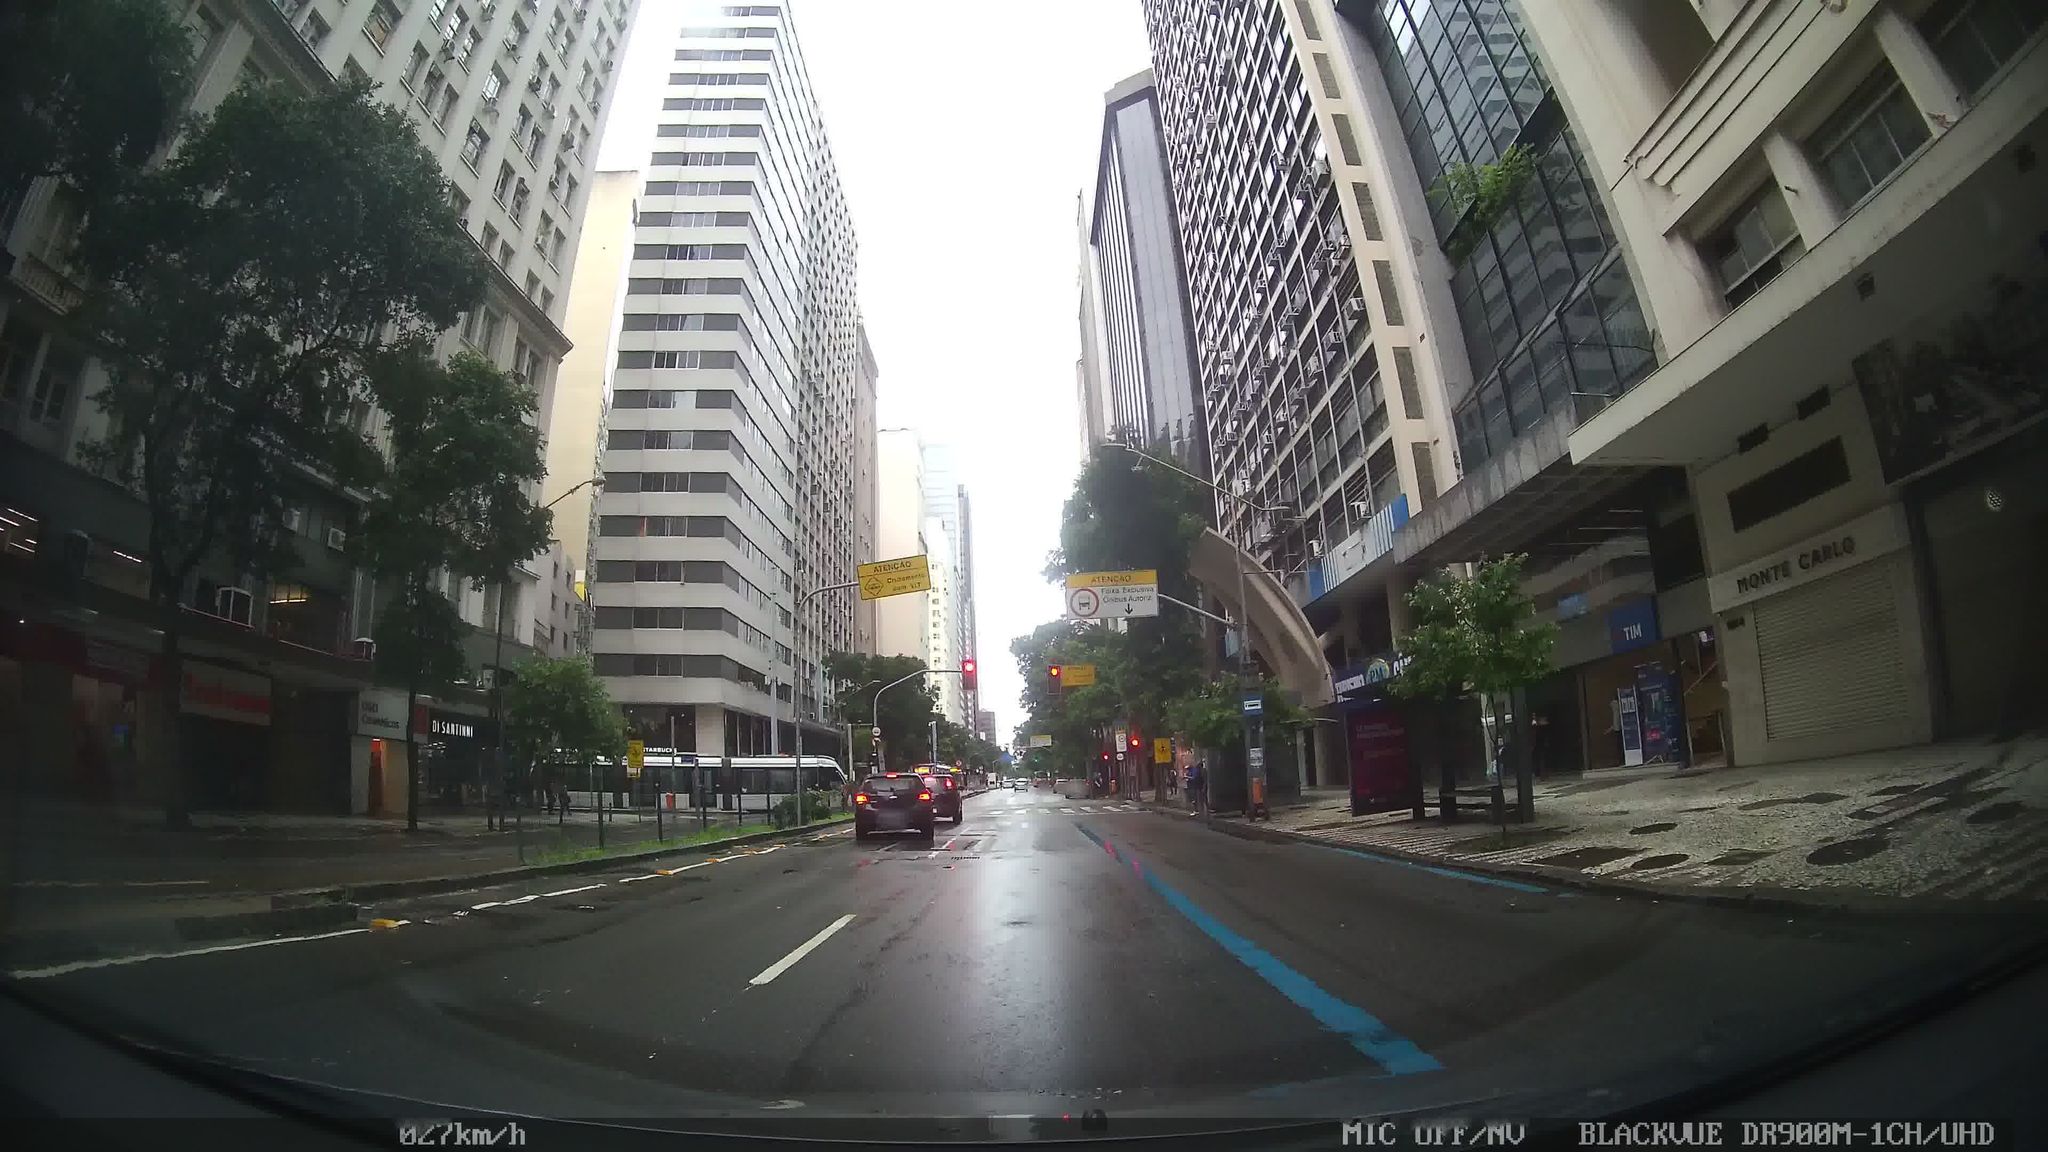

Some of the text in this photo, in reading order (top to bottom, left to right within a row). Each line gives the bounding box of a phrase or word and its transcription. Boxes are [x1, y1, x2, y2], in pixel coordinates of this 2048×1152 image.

[1737, 536, 1856, 594] MONTE CARLO
[1623, 623, 1643, 641] TIM
[432, 720, 440, 733] DI
